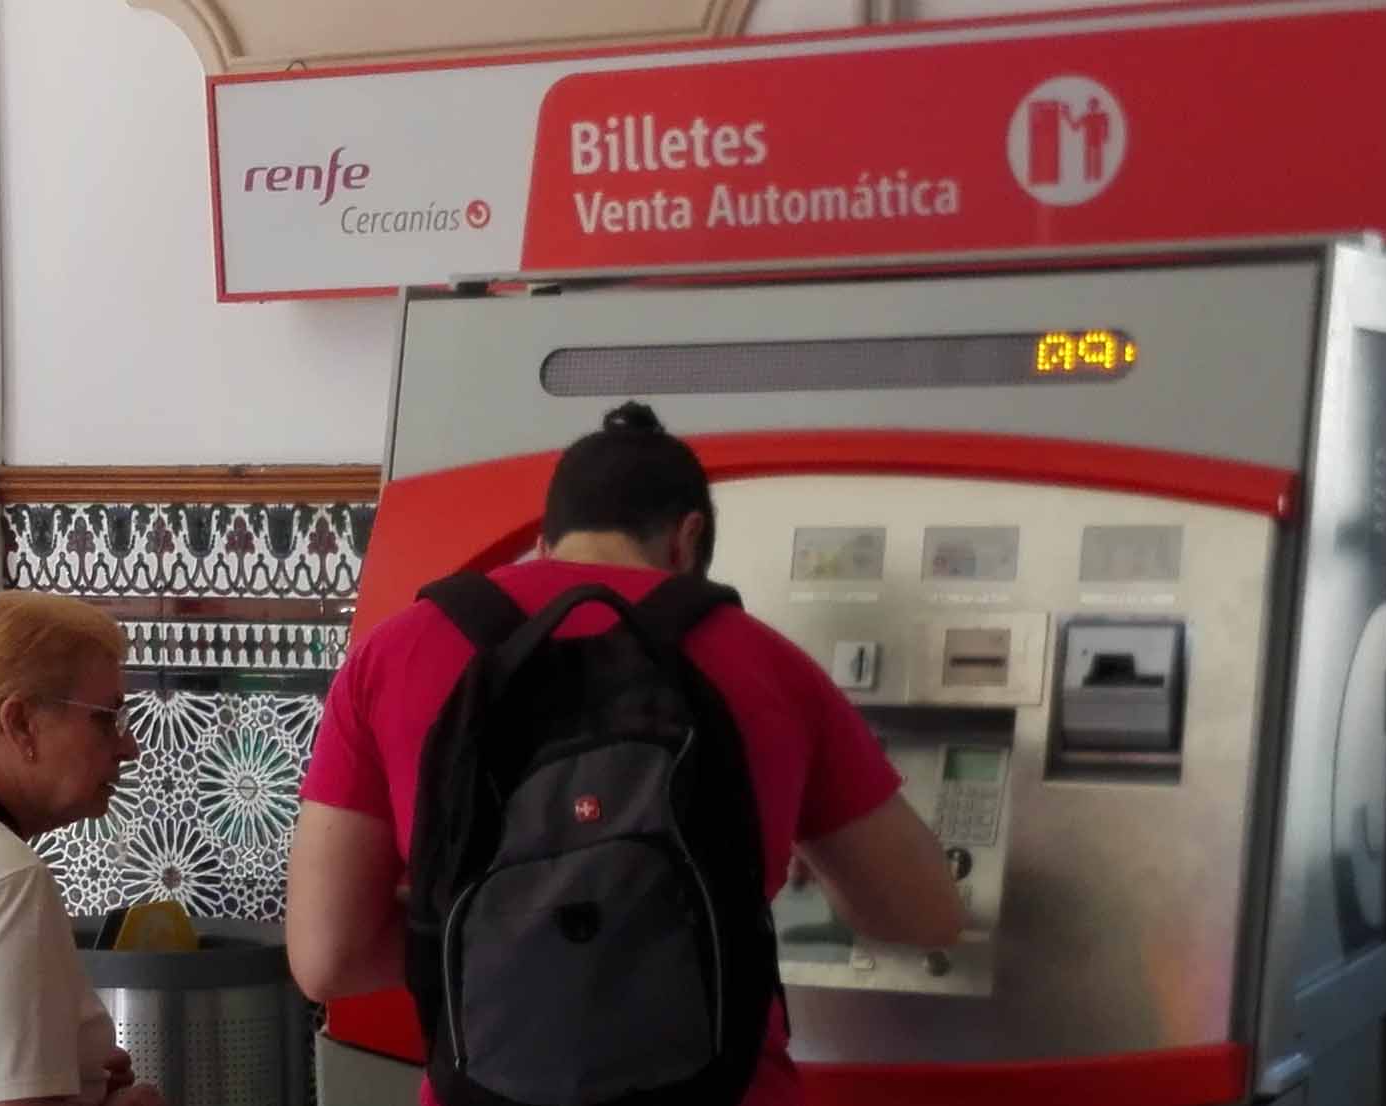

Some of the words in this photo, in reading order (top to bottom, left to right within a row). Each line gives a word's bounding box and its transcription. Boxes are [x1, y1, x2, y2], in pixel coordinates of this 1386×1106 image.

[570, 113, 767, 175] Billetes
[244, 146, 370, 205] renfe
[573, 190, 692, 234] Venta
[706, 170, 959, 229] Automática
[340, 202, 461, 234] Cercanías
